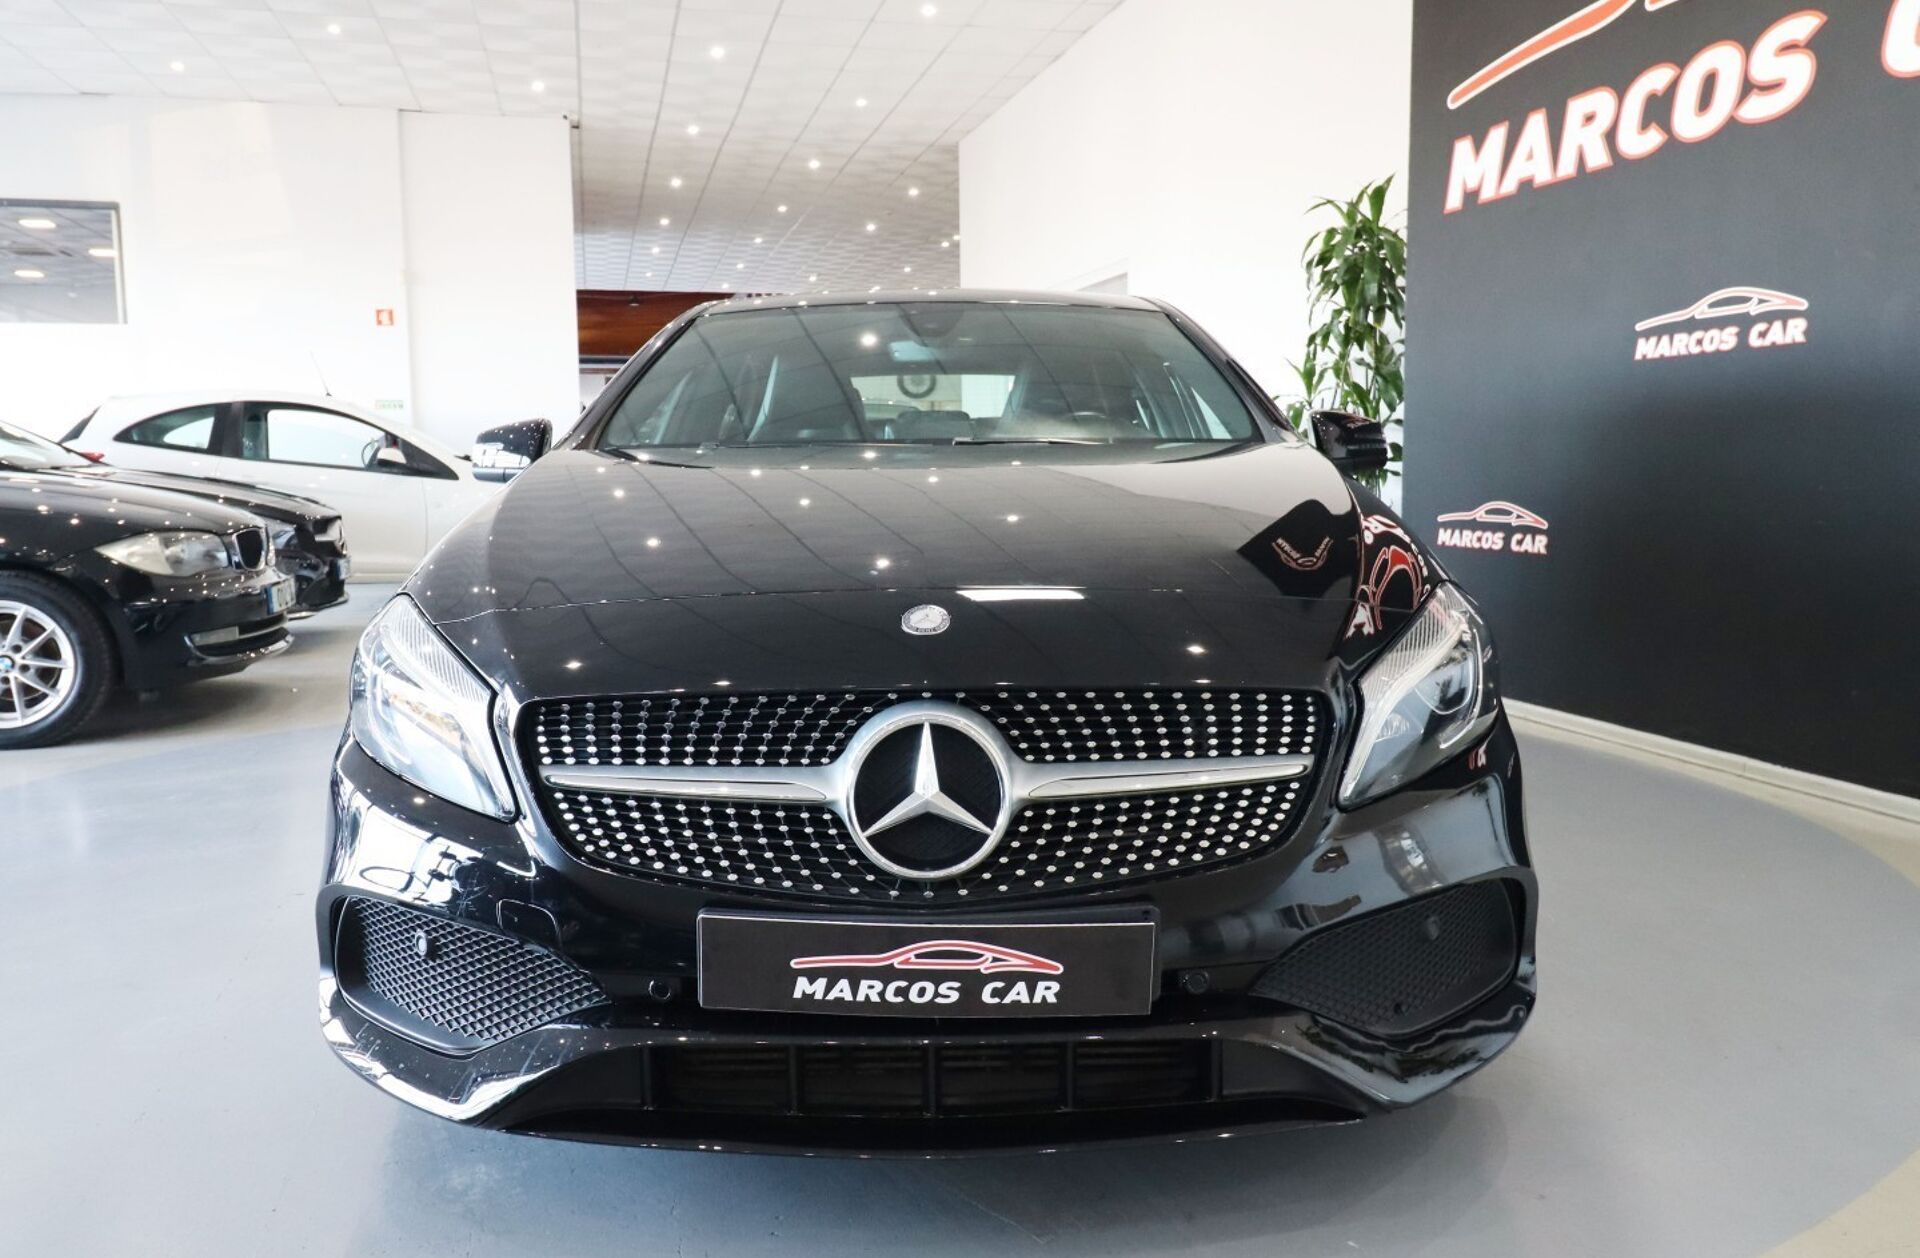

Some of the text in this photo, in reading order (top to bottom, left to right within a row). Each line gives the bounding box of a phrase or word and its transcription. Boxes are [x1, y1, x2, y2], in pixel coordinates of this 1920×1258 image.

[1443, 10, 1828, 214] MARCOS
[1634, 317, 1808, 361] MARCOS CAR
[1437, 528, 1548, 555] MARCOS CAR
[793, 976, 1060, 1004] MARCOS CAR
